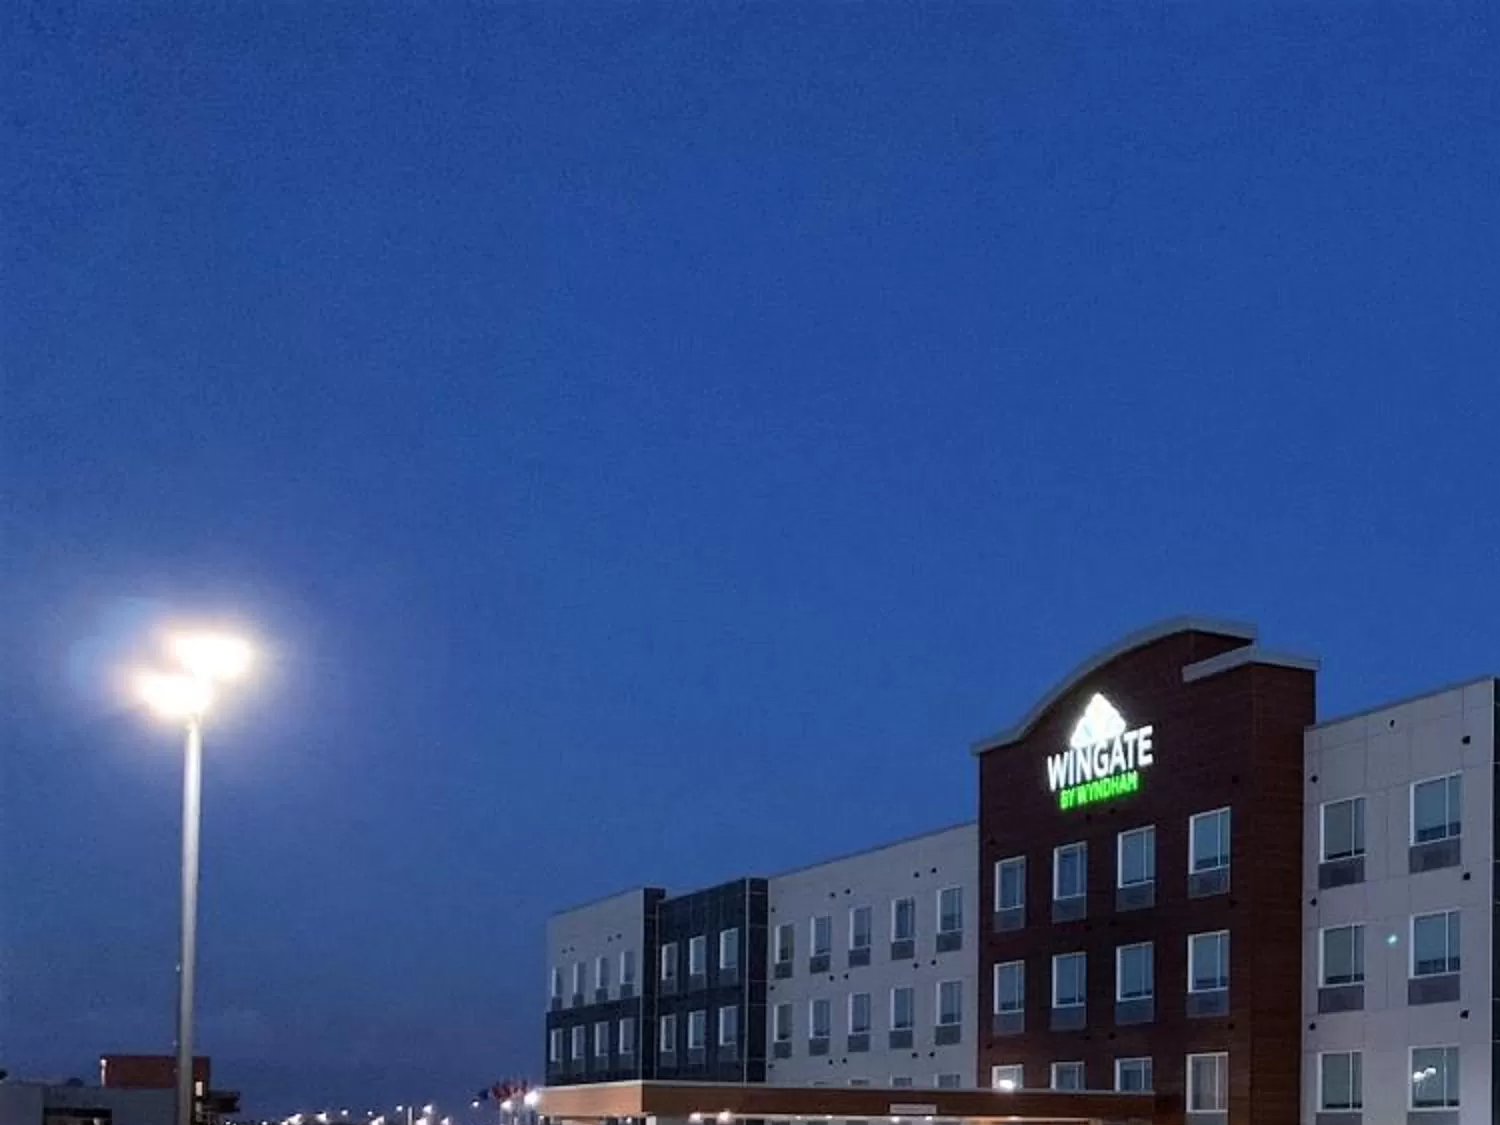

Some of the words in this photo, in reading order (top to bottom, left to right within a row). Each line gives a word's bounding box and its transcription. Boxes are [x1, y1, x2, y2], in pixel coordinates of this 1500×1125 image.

[1047, 725, 1153, 792] WINGATE
[1060, 788, 1075, 810] BY
[1077, 770, 1139, 806] WYNDHAM
